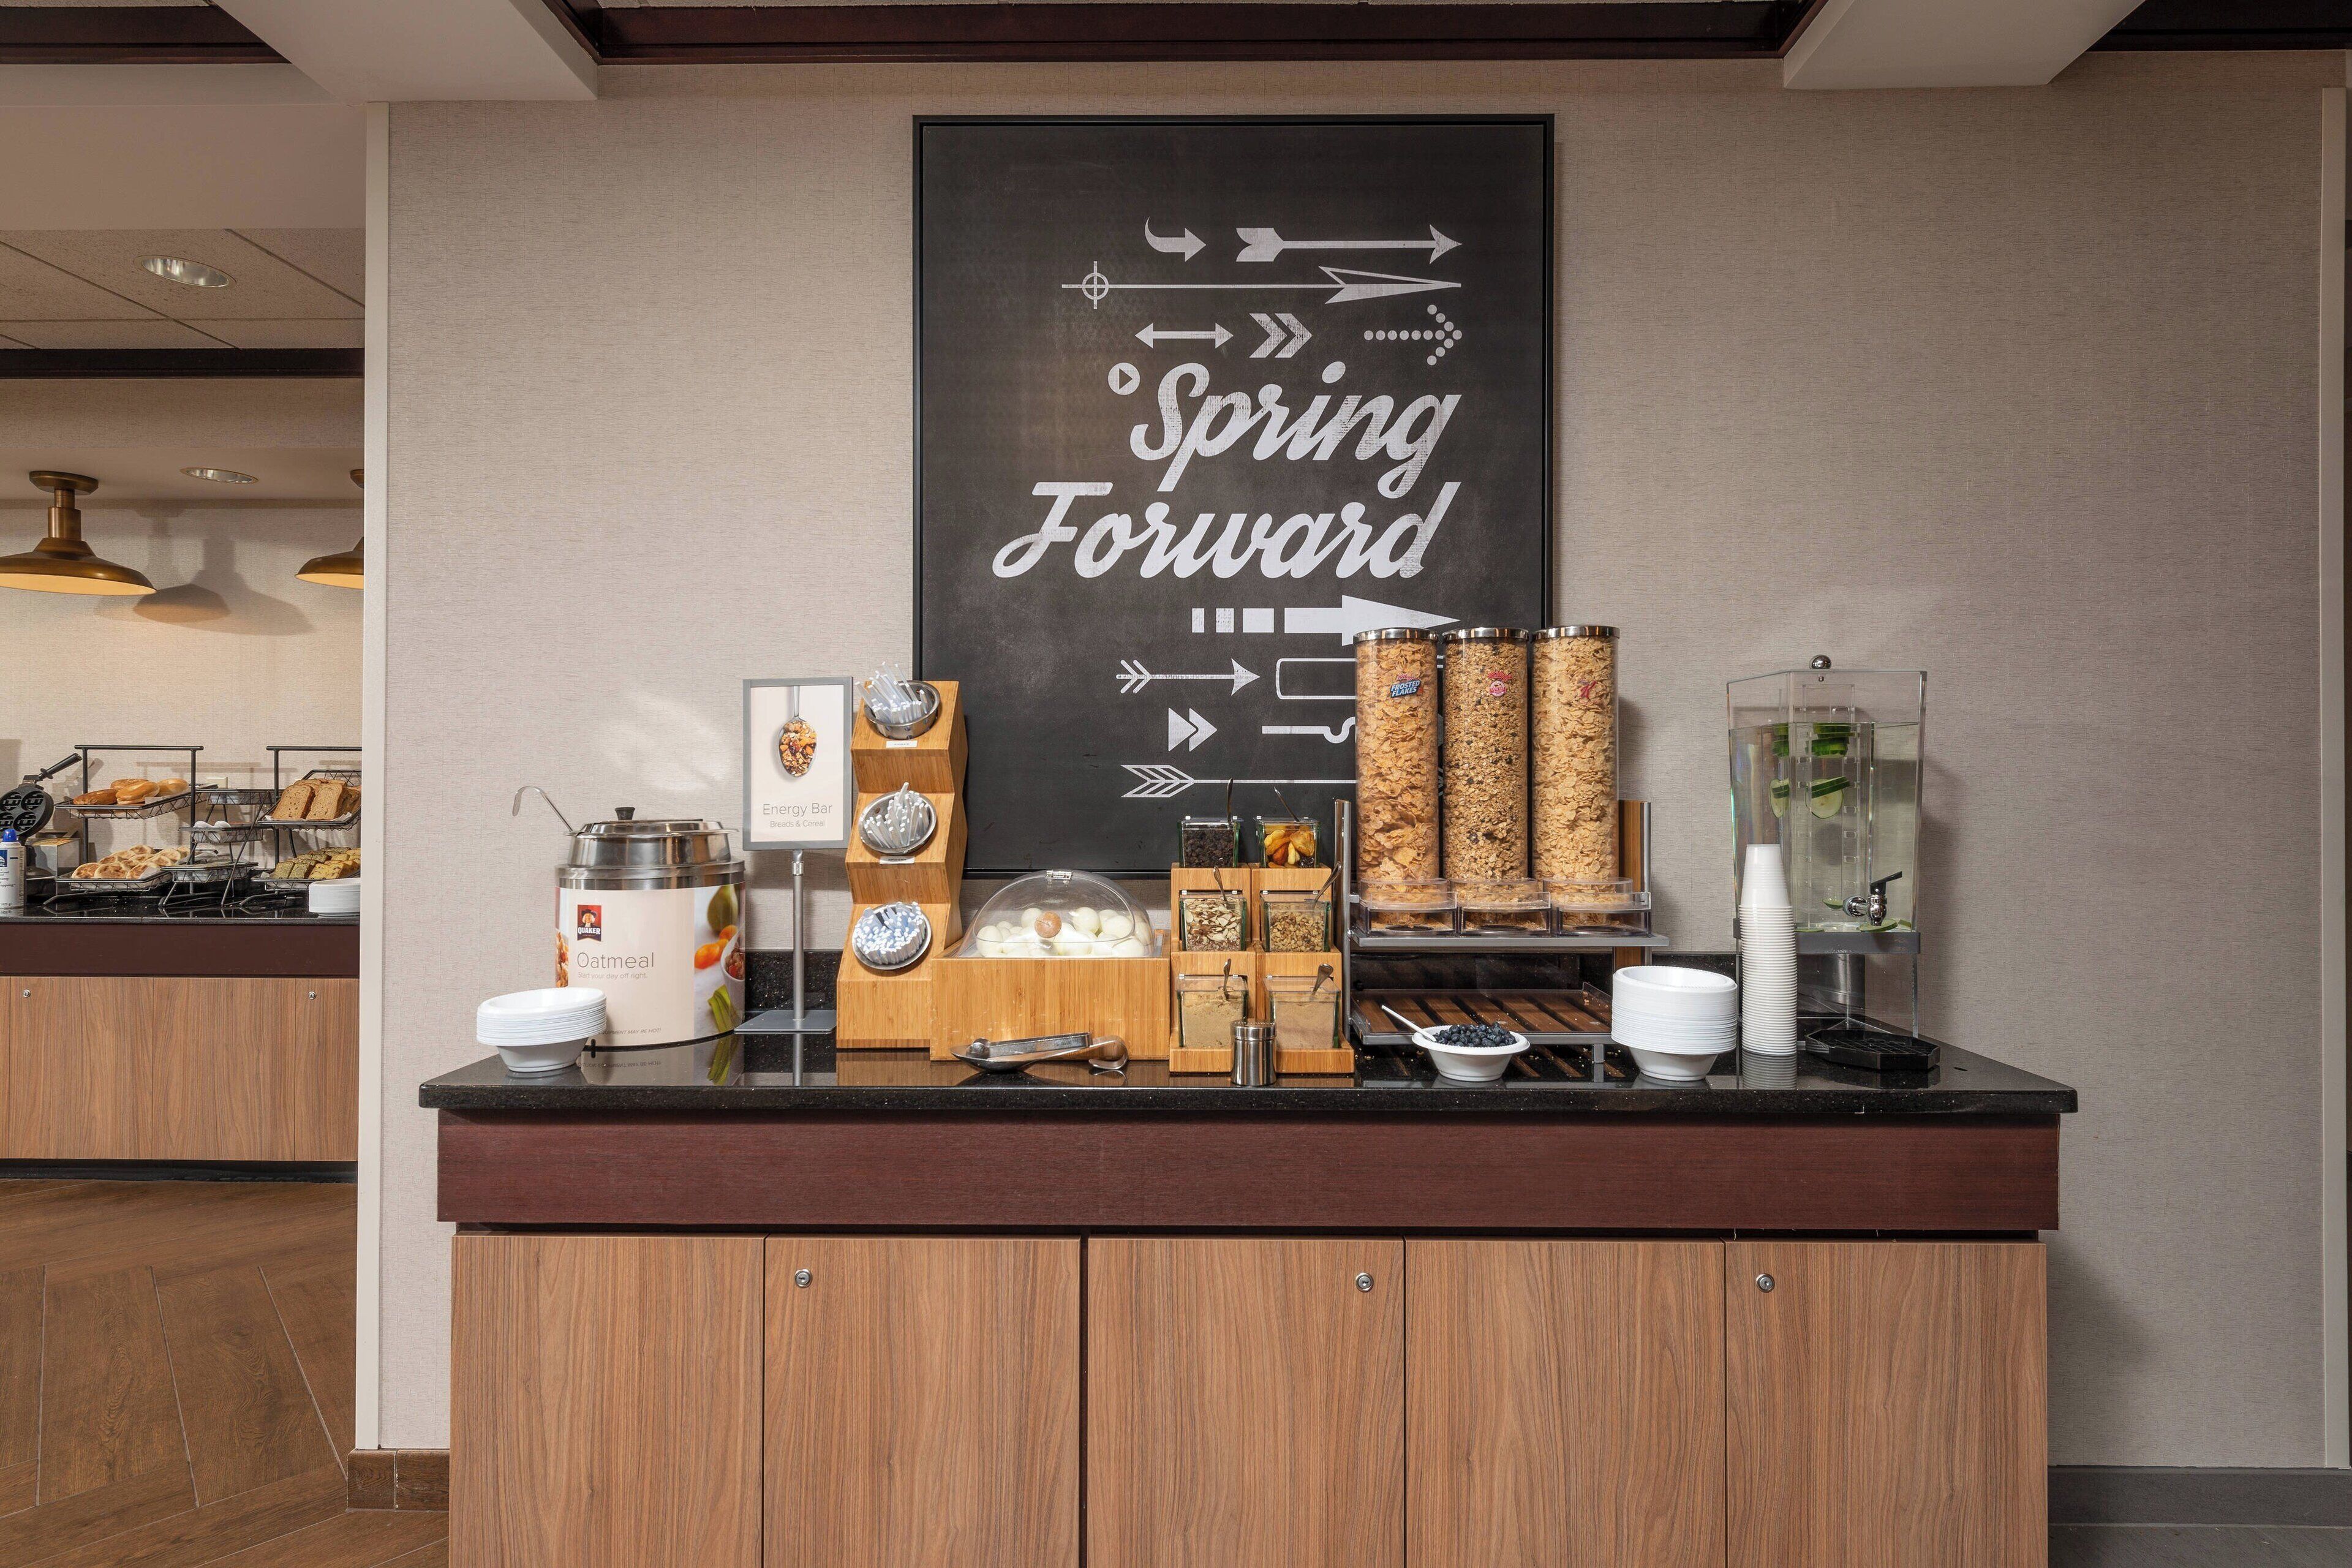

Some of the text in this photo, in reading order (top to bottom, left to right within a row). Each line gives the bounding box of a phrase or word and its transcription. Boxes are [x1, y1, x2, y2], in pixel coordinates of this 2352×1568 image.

[1130, 361, 1461, 499] Spring
[993, 481, 1461, 578] Forward
[1391, 680, 1420, 692] FROSTED
[1391, 686, 1417, 697] FLAKES
[763, 802, 832, 817] Energy Bar
[577, 952, 654, 969] Oatmeal
